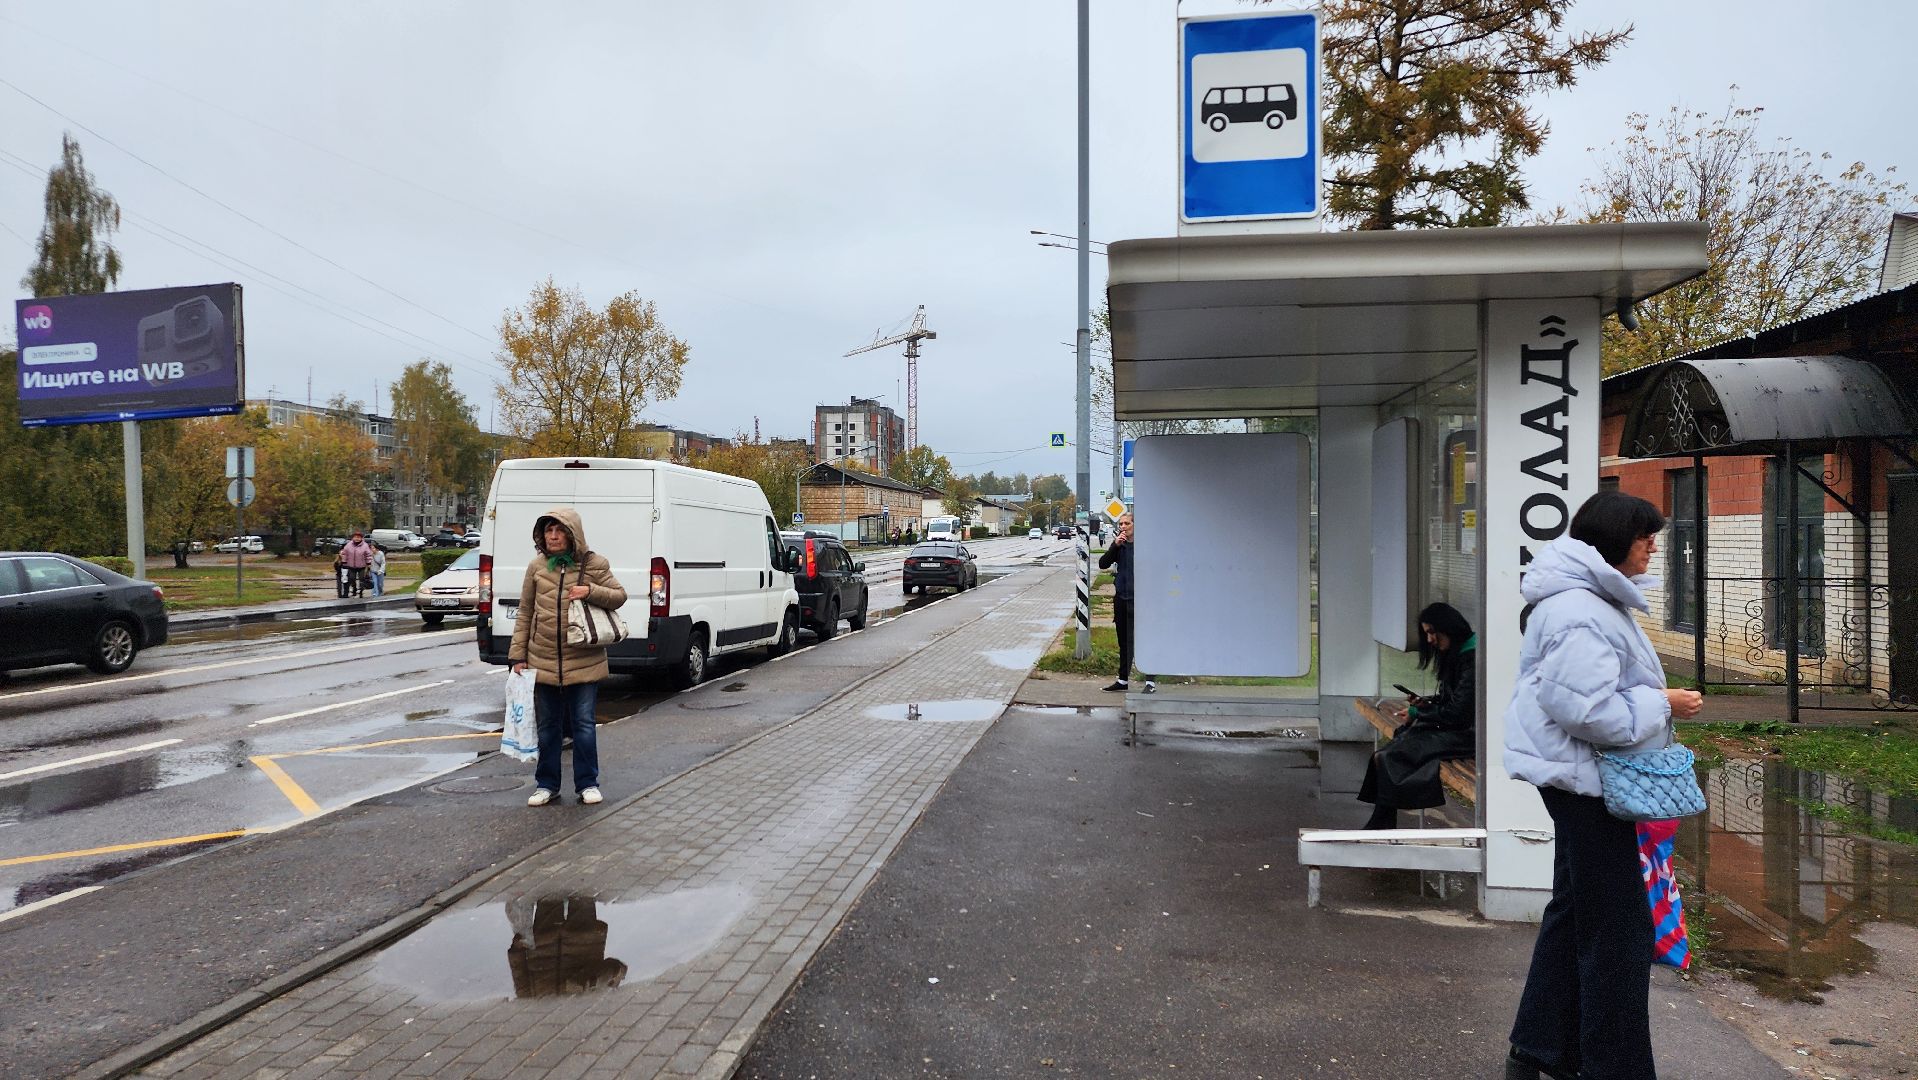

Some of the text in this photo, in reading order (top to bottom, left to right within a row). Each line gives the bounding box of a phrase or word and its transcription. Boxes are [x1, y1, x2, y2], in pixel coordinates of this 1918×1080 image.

[23, 361, 185, 389] Ищите на WB
